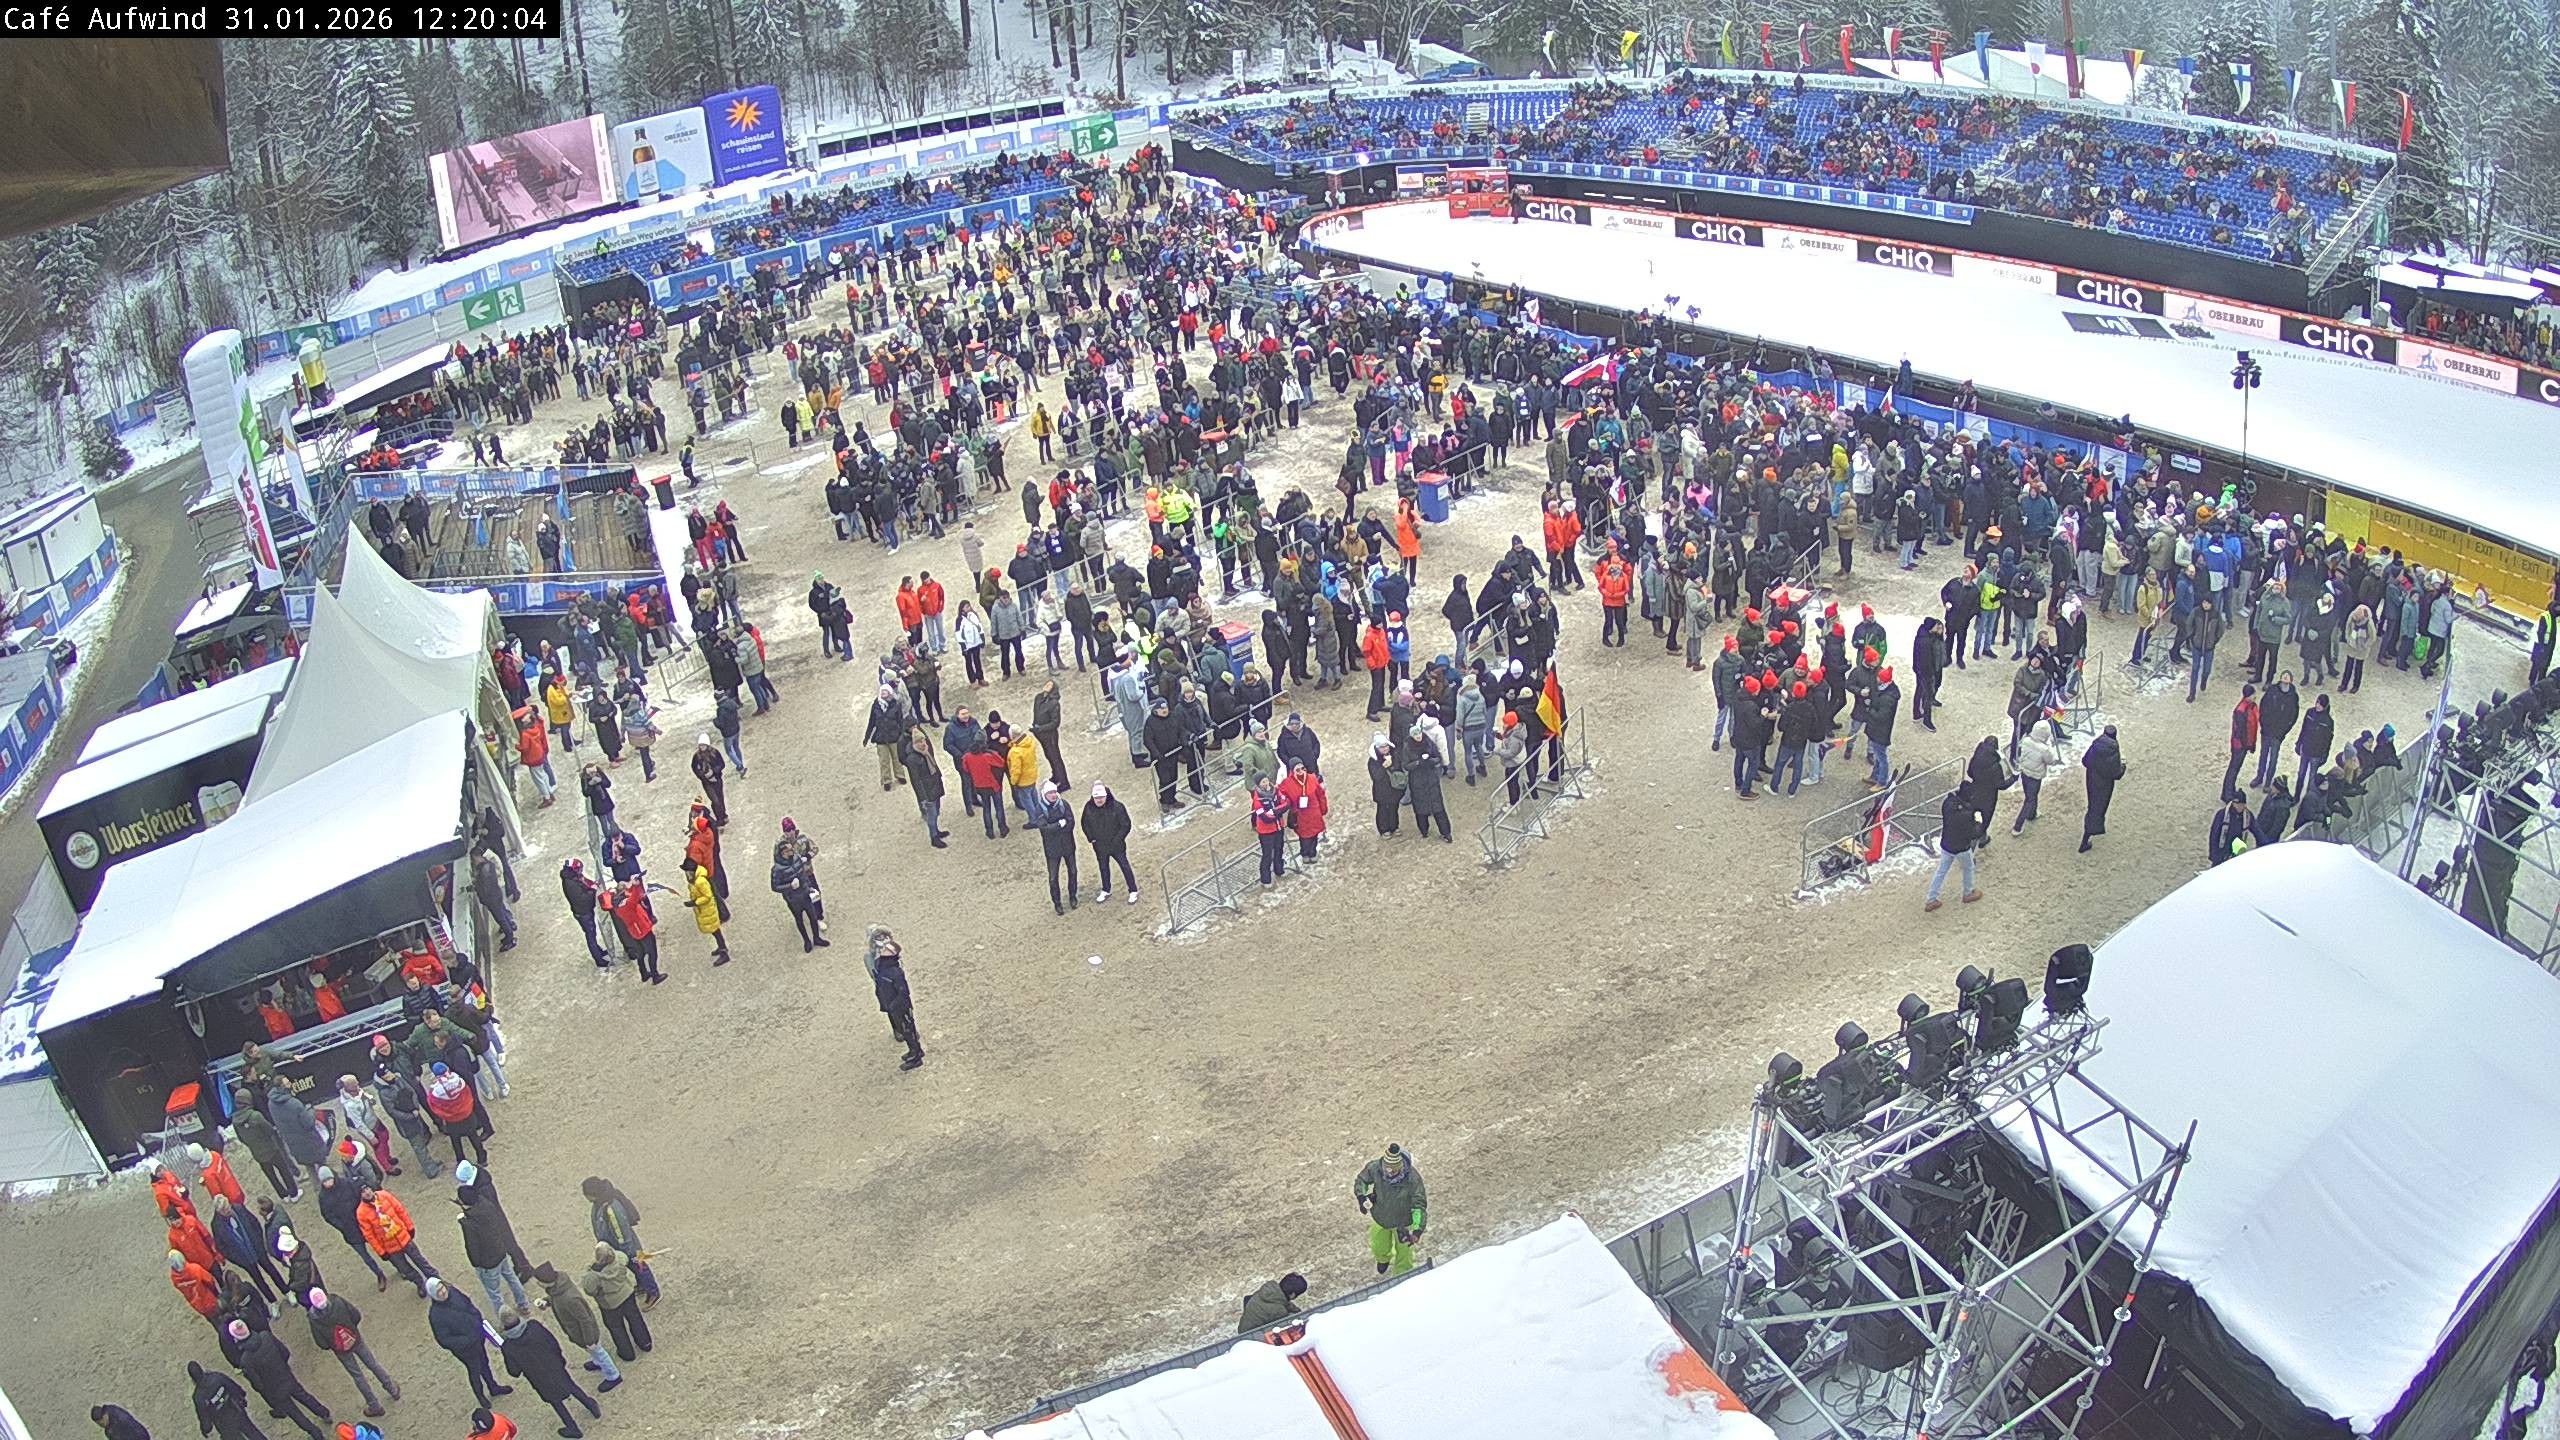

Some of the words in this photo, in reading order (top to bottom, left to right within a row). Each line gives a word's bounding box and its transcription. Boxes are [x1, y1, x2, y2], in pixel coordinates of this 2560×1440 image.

[2383, 510, 2402, 525] EXIT
[2429, 524, 2447, 539] EXIT
[2475, 541, 2494, 556] EXIT
[2521, 560, 2540, 575] EXIT
[98, 800, 197, 855] Warsteiner
[291, 1075, 316, 1096] einer
